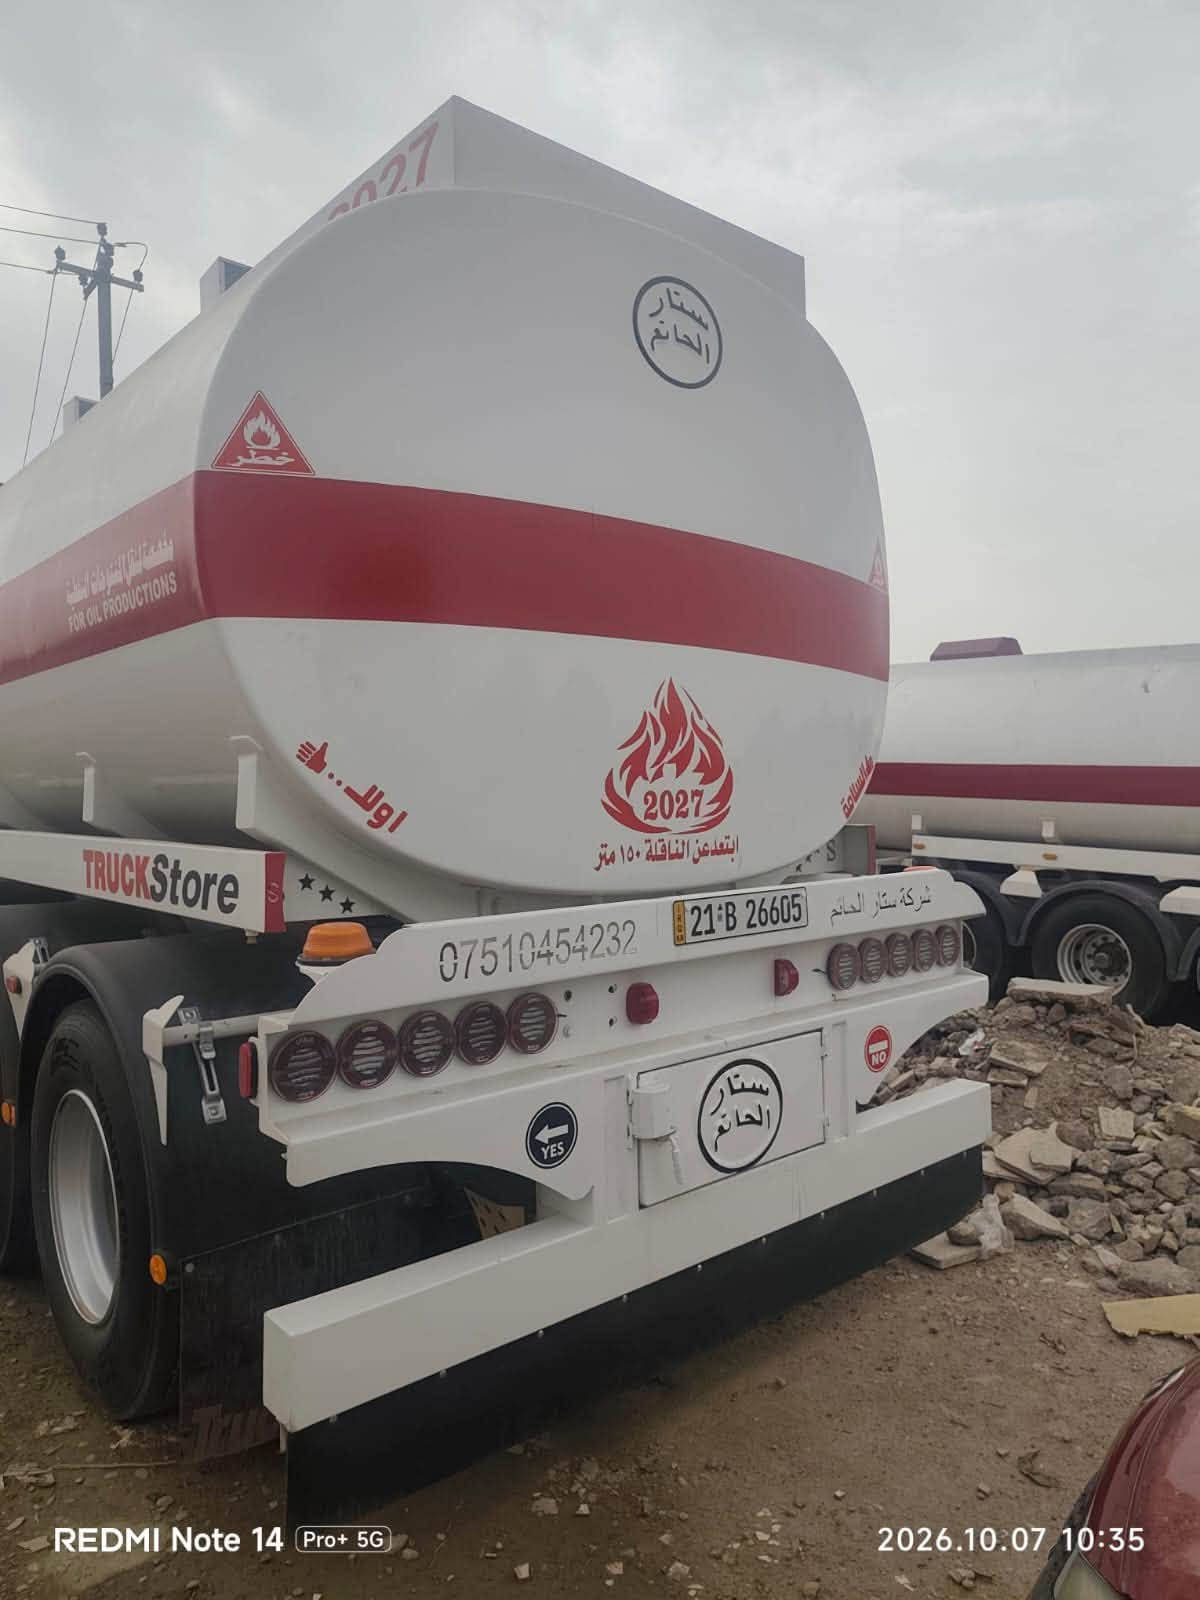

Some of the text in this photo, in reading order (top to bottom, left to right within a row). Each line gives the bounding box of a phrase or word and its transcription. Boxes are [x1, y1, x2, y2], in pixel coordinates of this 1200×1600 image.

[649, 287, 709, 331] ستار
[227, 449, 295, 466] خطر
[68, 571, 177, 632] FOR OIL PRODUCTIONS
[643, 789, 704, 821] 2027
[593, 842, 616, 872] متر
[645, 838, 690, 862] الناقلة
[82, 850, 240, 914] TRUCKStore
[872, 890, 897, 919] ستار
[899, 884, 931, 913] شركة
[690, 893, 802, 937] 21 B 26605
[439, 919, 637, 983] 07510454232
[871, 1051, 887, 1066] NO
[710, 1074, 769, 1116] ستار
[541, 1141, 565, 1160] YES
